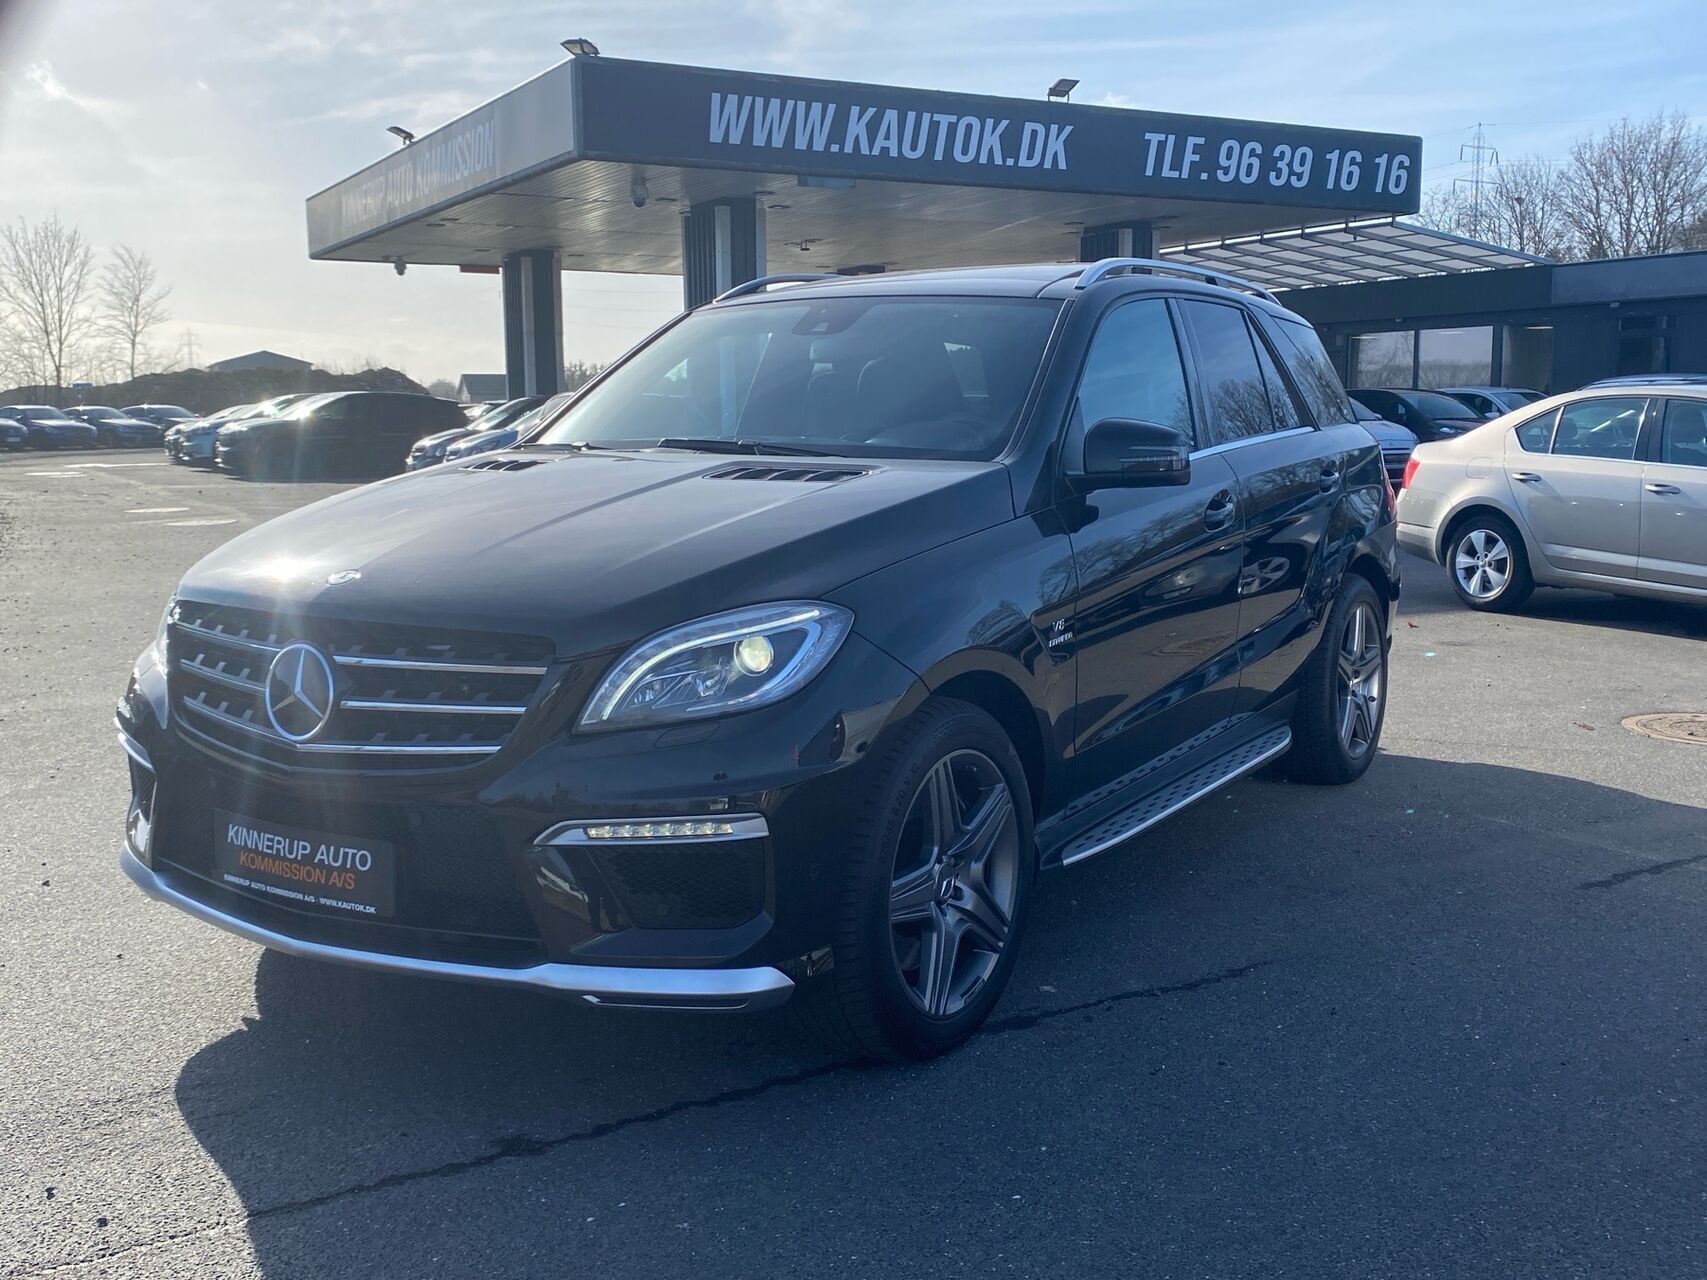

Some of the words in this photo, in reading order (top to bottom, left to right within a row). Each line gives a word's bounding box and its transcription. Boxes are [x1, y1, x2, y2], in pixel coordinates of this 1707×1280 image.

[709, 92, 1074, 170] WWW.KAUTOK.DK
[388, 161, 414, 206] AUTO
[415, 119, 496, 199] KOMMISSION
[1144, 132, 1208, 180] TLF.
[1216, 139, 1263, 184] 96
[1269, 144, 1314, 188] 39
[1325, 149, 1363, 191] 16
[1374, 154, 1411, 195] 16
[227, 823, 311, 860] KINNERUP
[314, 844, 372, 871] AUTO
[239, 851, 326, 884] KOMMISSION
[328, 872, 355, 890] A/S
[251, 881, 266, 892] AUTO
[319, 897, 376, 914] WWW.KAUTOK.DK
